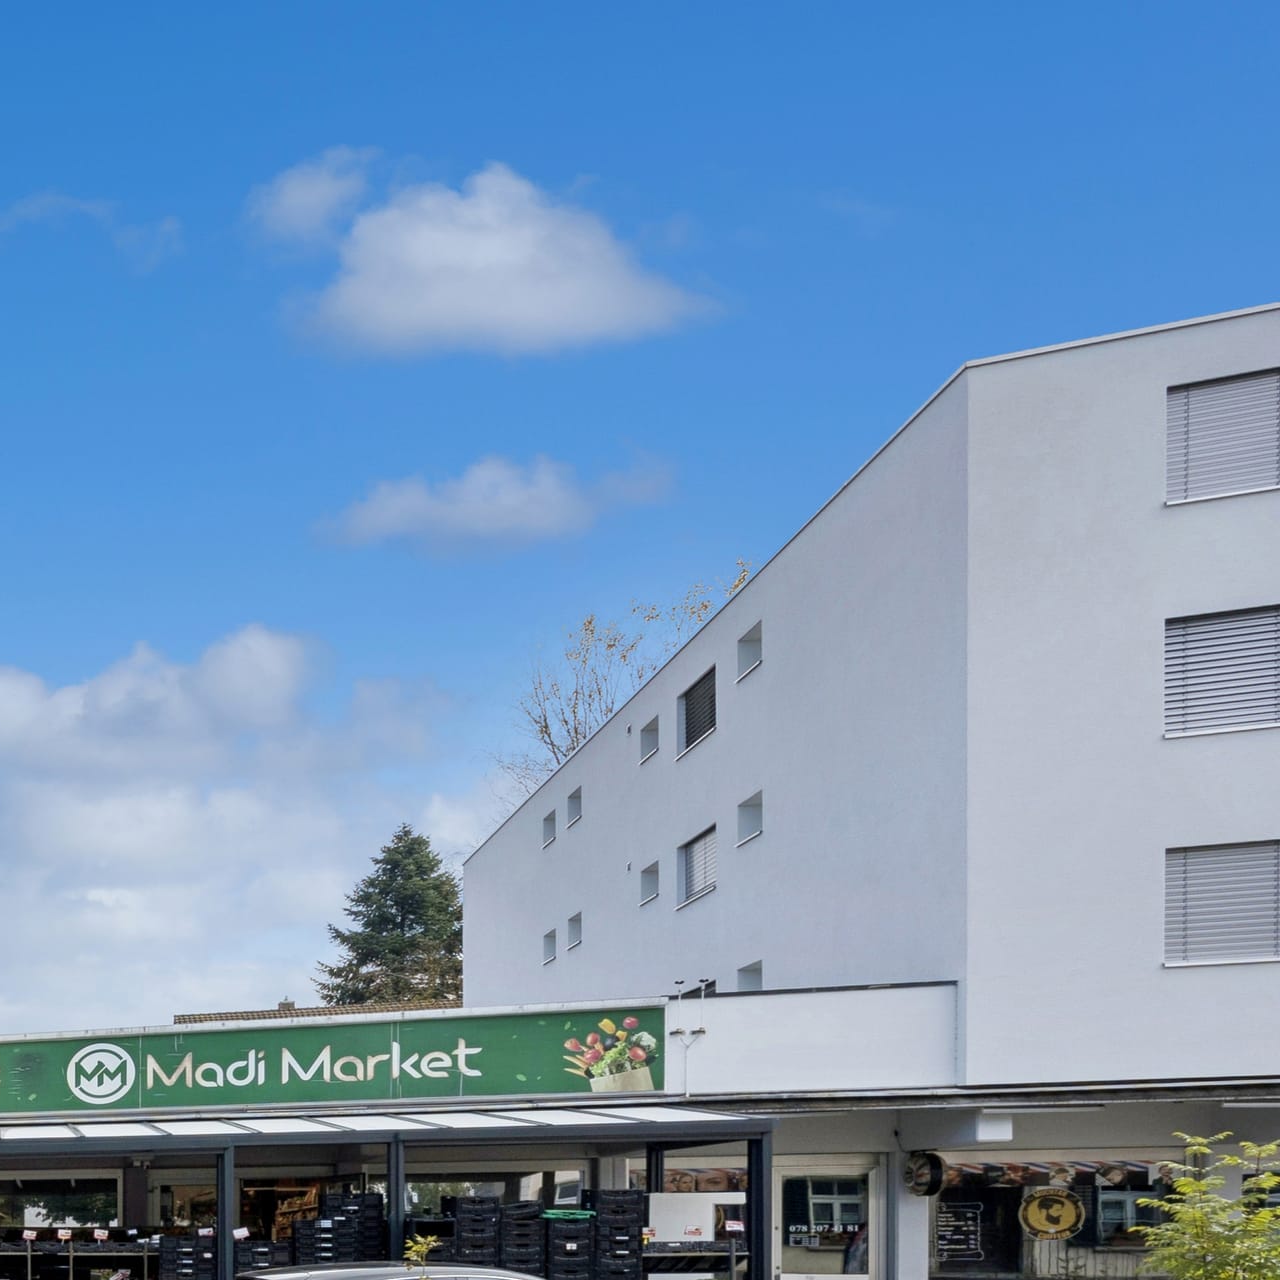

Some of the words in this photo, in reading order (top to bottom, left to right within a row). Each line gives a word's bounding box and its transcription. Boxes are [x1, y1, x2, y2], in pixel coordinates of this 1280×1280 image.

[146, 1050, 266, 1089] Madi
[281, 1037, 483, 1085] Market
[789, 1224, 808, 1232] 078
[847, 1224, 860, 1232] 81
